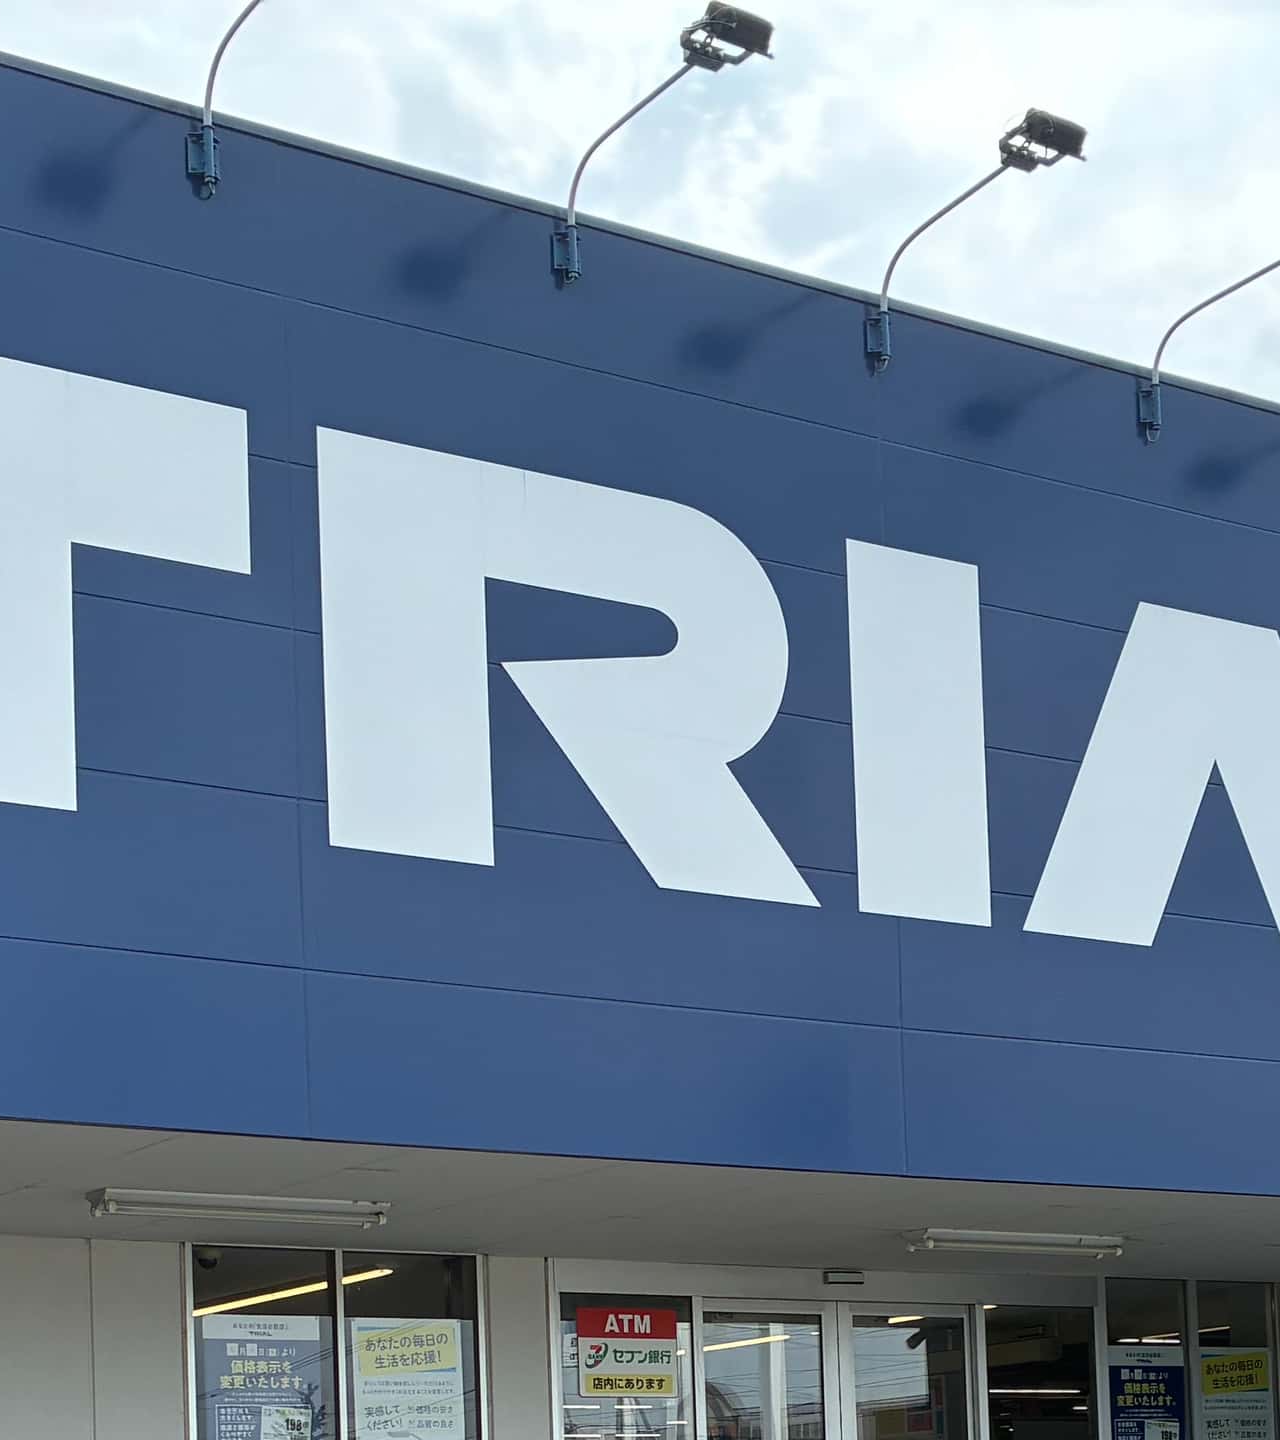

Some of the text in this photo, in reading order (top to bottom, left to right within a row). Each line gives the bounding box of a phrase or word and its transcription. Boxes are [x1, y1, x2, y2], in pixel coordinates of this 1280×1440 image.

[604, 1313, 651, 1334] ATM
[365, 1333, 449, 1352] あなたの毎日の
[612, 1348, 672, 1365] セブン銀行
[592, 1377, 665, 1390] 店内にあります
